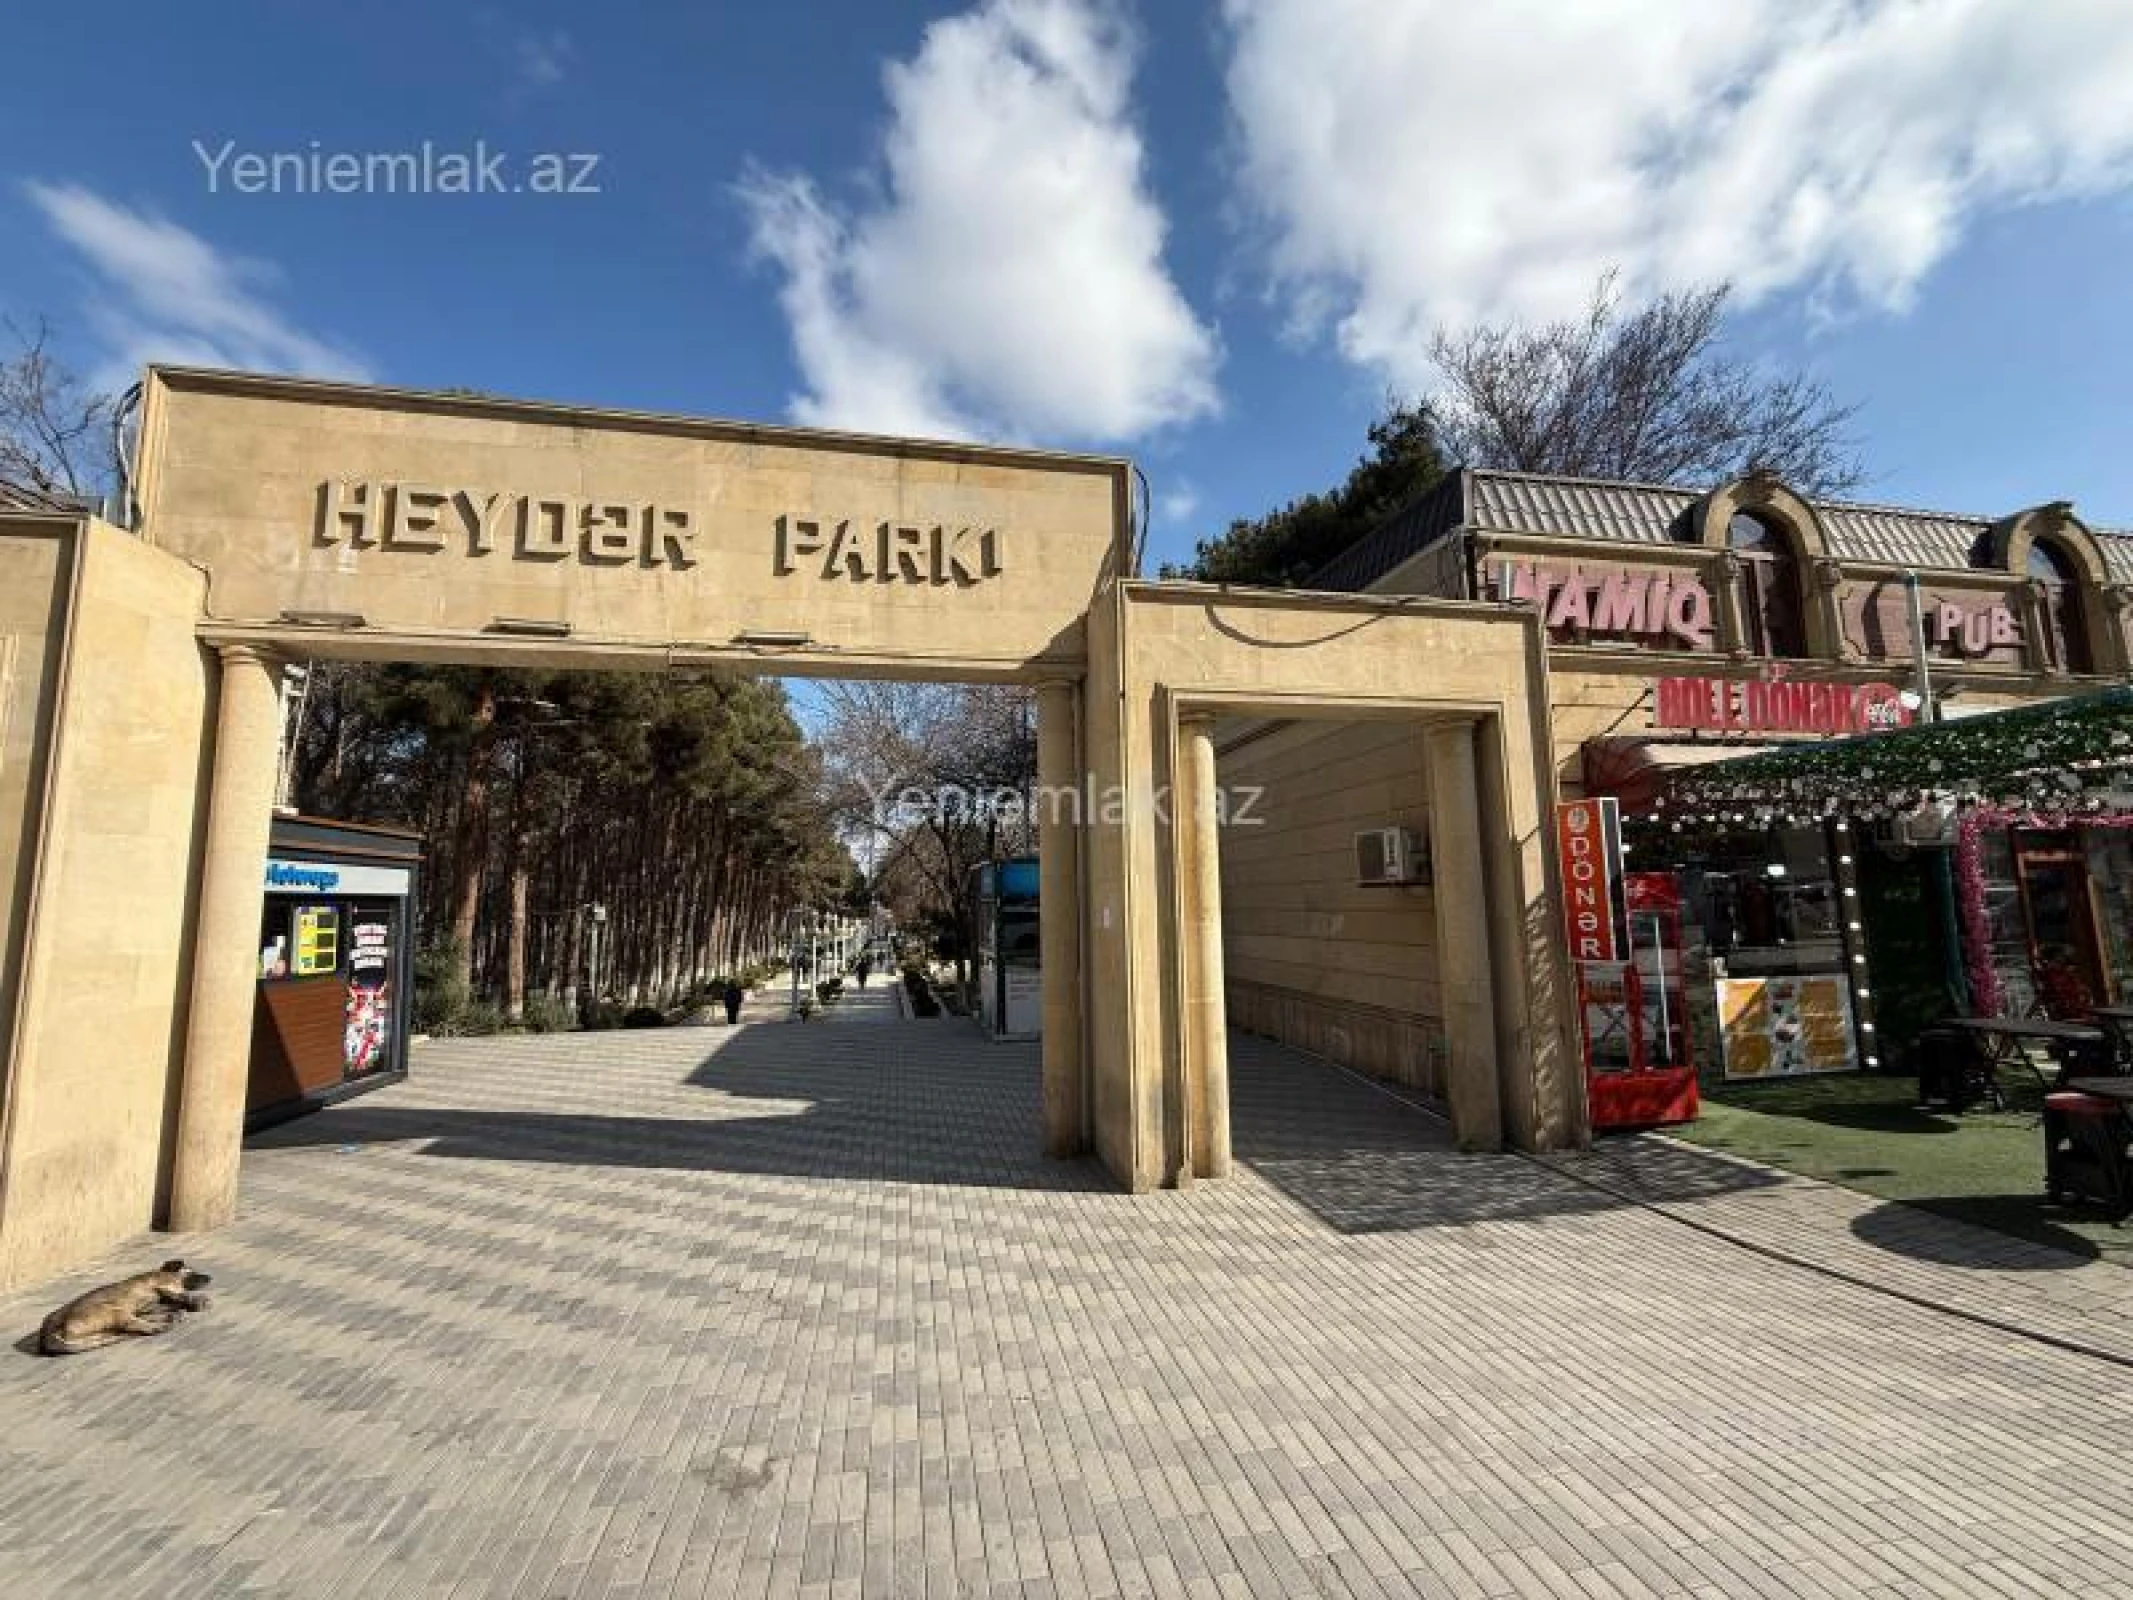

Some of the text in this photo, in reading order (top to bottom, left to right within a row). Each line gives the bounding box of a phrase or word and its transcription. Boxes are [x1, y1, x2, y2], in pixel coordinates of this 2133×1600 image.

[312, 475, 1004, 588] HEYDƏR PARKI
[1939, 603, 2020, 651] PUB
